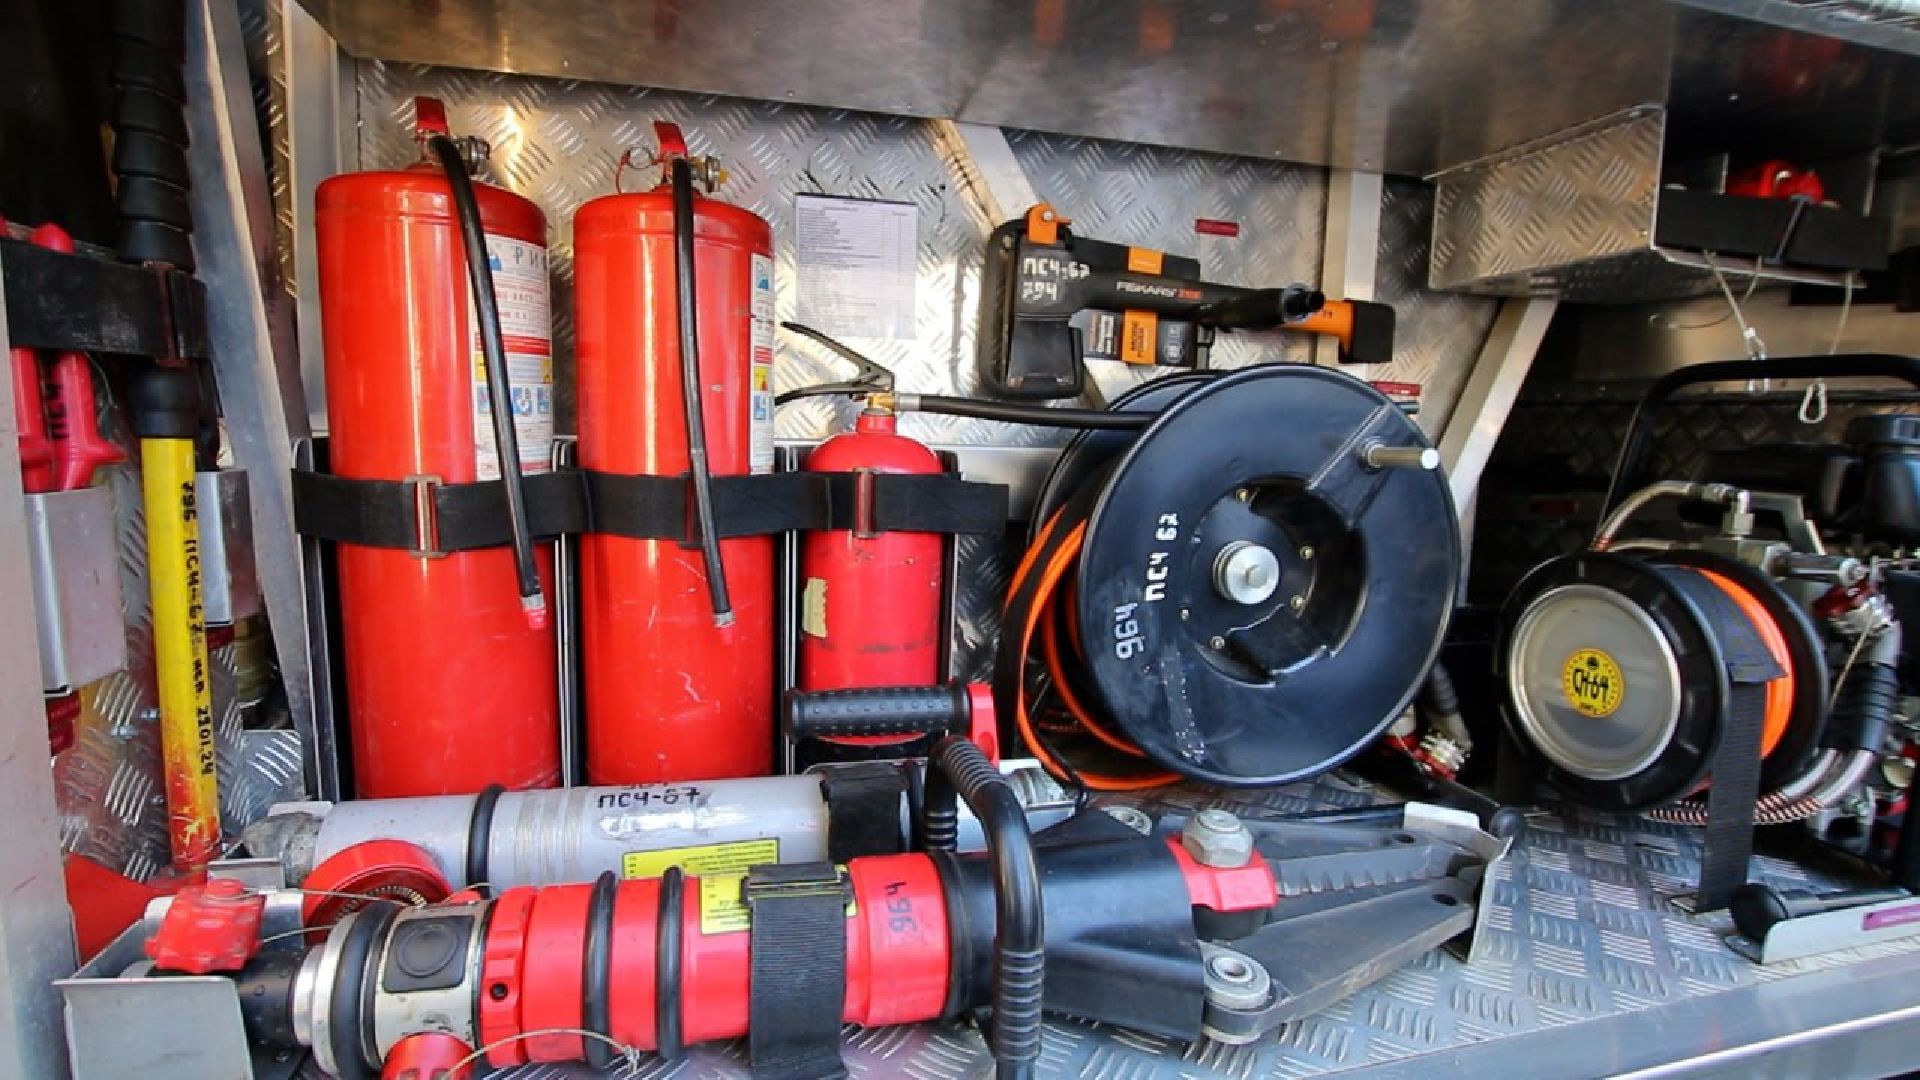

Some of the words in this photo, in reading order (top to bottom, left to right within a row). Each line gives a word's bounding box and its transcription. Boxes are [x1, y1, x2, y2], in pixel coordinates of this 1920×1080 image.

[1144, 552, 1169, 601] ПСЧ
[1114, 602, 1147, 659] 964
[597, 787, 701, 809] ПСЧ-67
[885, 882, 918, 932] 964
